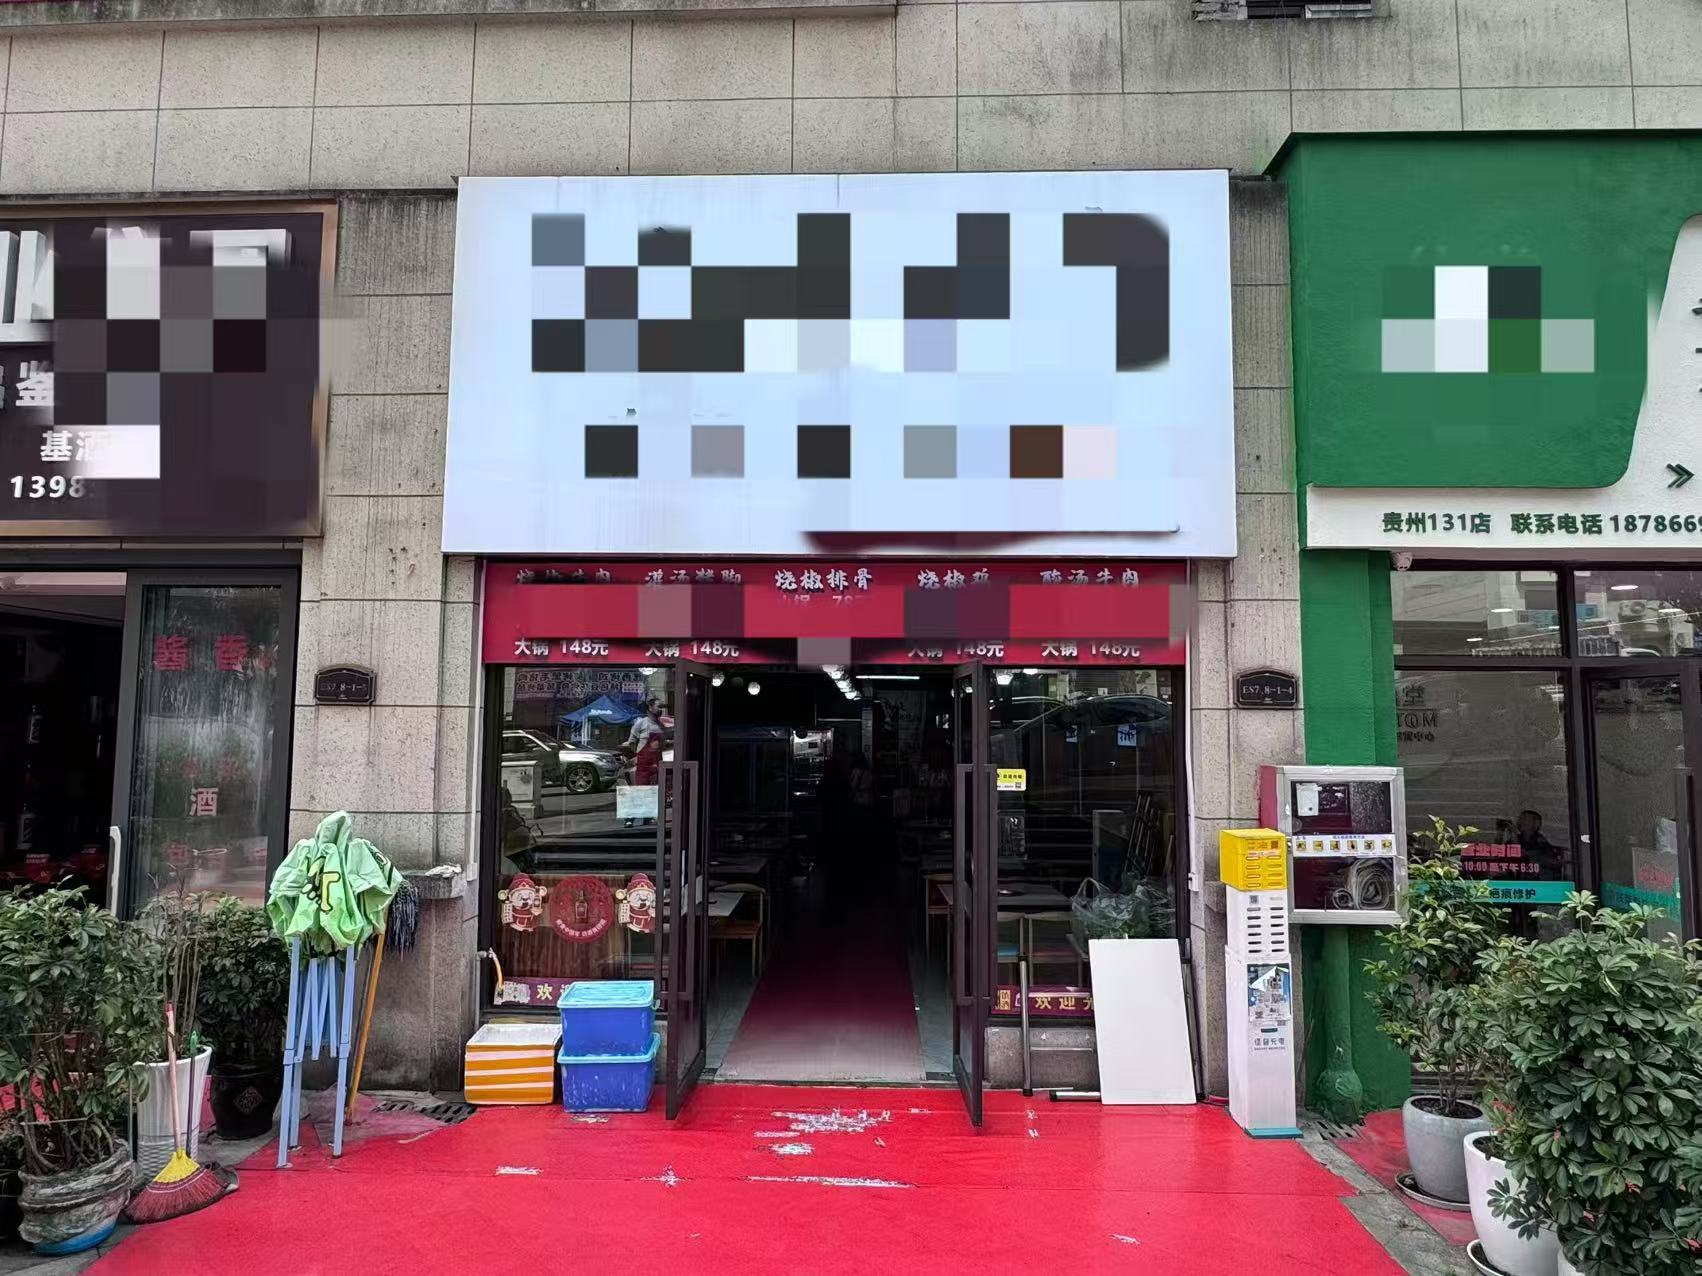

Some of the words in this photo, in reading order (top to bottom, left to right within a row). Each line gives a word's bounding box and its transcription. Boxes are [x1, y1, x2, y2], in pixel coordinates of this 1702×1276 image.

[1382, 511, 1491, 534] 贵州131店
[1510, 513, 1603, 535] 联系电话
[775, 567, 872, 591] 烧椒排骨
[514, 637, 549, 655] 大锅
[560, 639, 609, 655] 148元
[690, 640, 740, 656] 148元
[1041, 640, 1078, 657] 大锅
[1090, 641, 1141, 657] 148元
[190, 787, 219, 817] 酒
